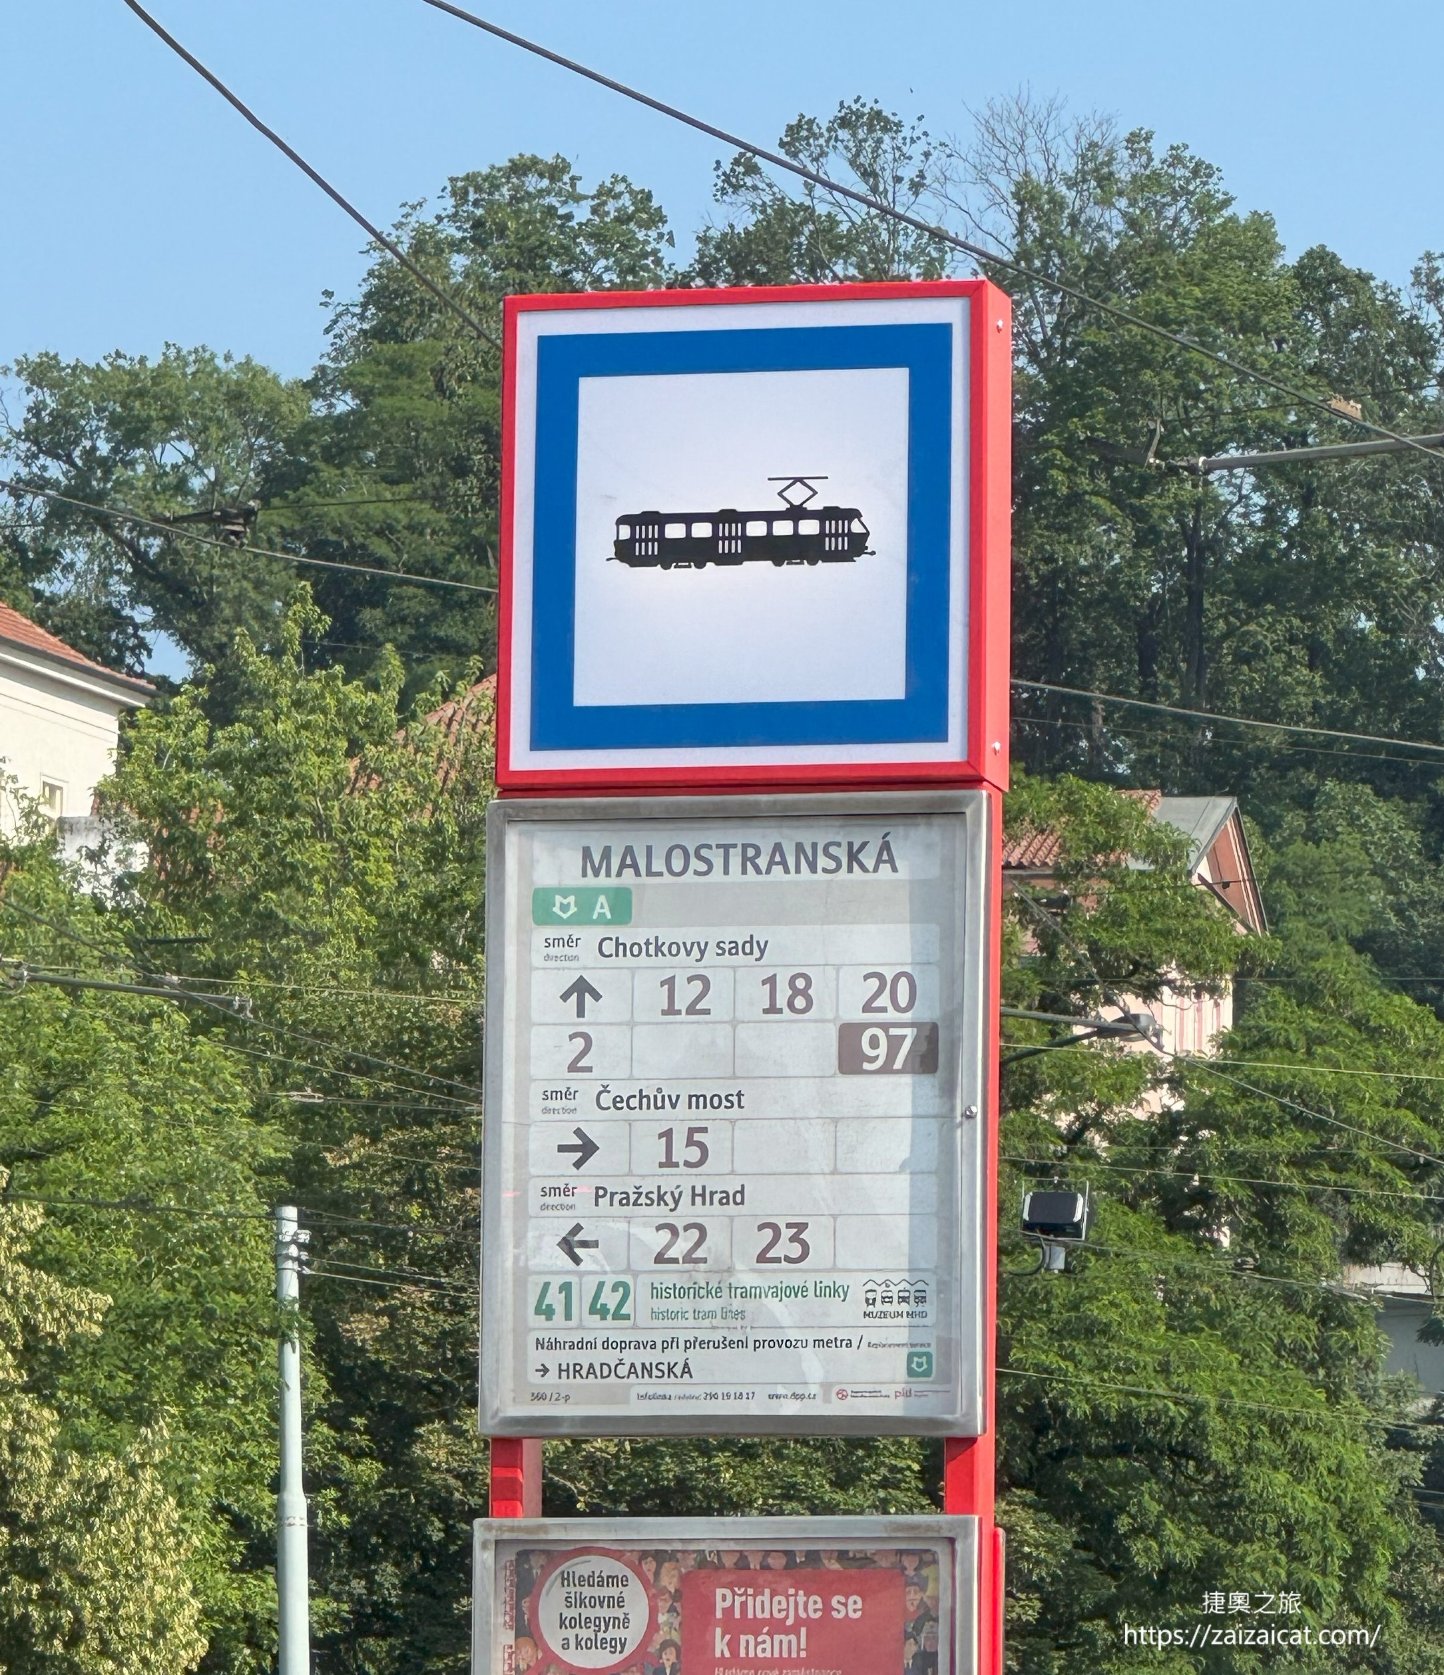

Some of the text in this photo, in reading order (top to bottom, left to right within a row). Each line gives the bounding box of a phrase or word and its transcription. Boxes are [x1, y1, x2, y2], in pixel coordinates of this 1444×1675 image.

[580, 831, 899, 879] MALOSTRANSKÁ
[592, 894, 612, 920] A
[543, 933, 769, 963] směr Chotkovy sady
[660, 970, 918, 1016] 12 18 20
[566, 1026, 918, 1074] 2 97
[541, 1083, 746, 1111] směr Čechův most
[657, 1126, 710, 1169] 15
[539, 1182, 746, 1212] směr Pražský Hrad
[653, 1221, 811, 1266] 22 23
[534, 1280, 850, 1321] 41 42 historické tramvajové linky
[692, 1308, 717, 1321] tram
[535, 1336, 598, 1351] Náhradní
[601, 1336, 657, 1354] doprava
[753, 1337, 809, 1352] provozu
[812, 1336, 853, 1350] metra
[557, 1357, 694, 1380] HRADČANSKÁ
[560, 1570, 629, 1588] Hledáme
[564, 1591, 625, 1609] šikovné
[715, 1587, 863, 1626] Přidejte se
[559, 1612, 630, 1634] kolegyně
[561, 1633, 628, 1655] a kolegy
[714, 1626, 808, 1659] k nám!
